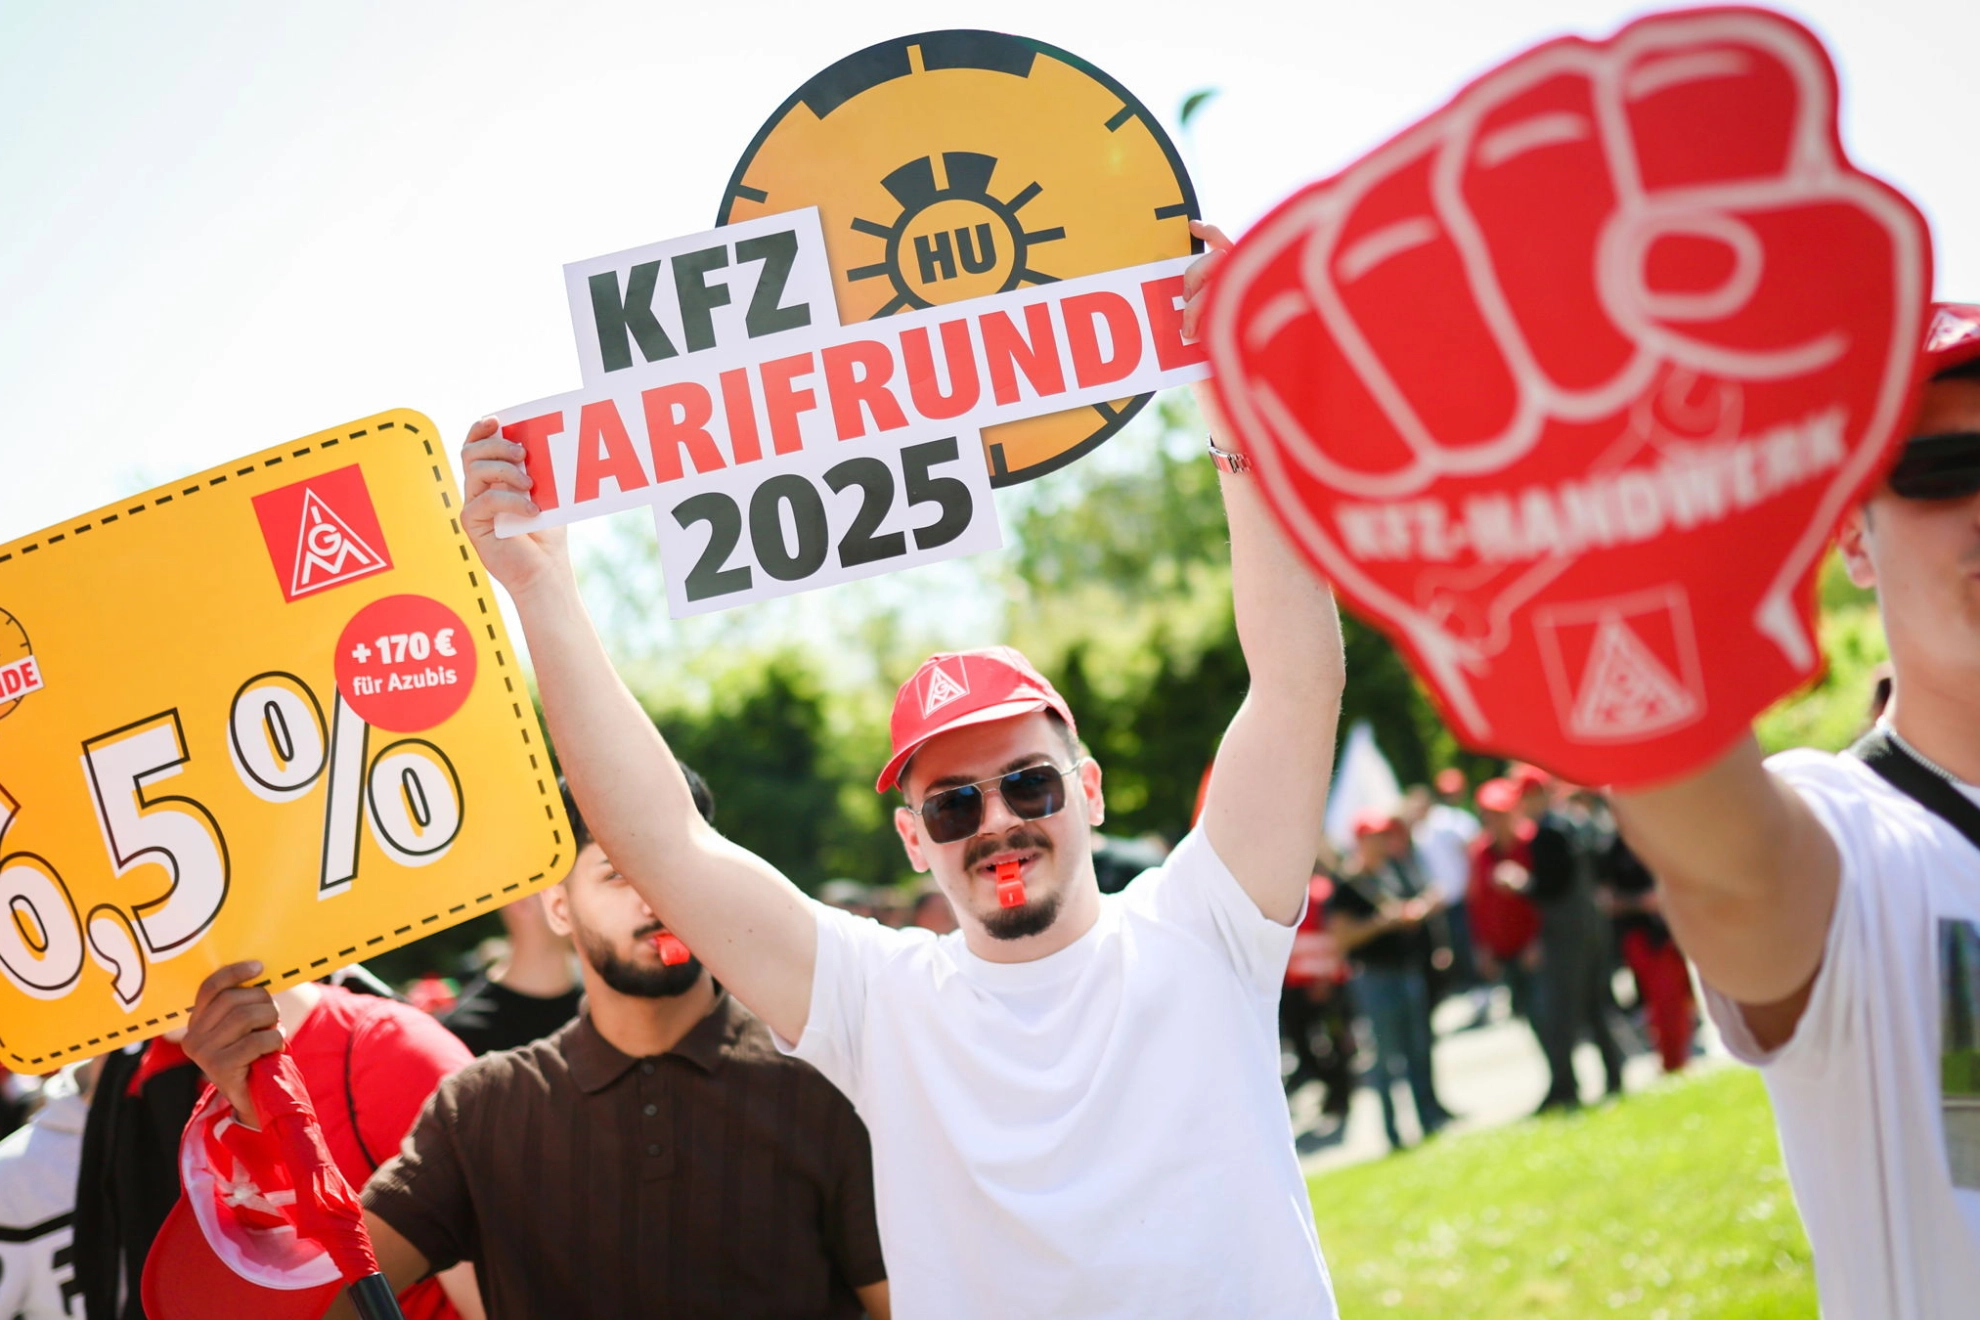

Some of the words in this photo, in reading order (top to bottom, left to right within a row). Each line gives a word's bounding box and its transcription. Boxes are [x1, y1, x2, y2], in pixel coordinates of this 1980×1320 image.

[588, 229, 811, 374] KFZ
[913, 222, 997, 285] HU
[501, 272, 1212, 512] TARIFRUNDE
[670, 436, 974, 603] 2025
[353, 676, 383, 696] für
[388, 665, 458, 692] Azubis
